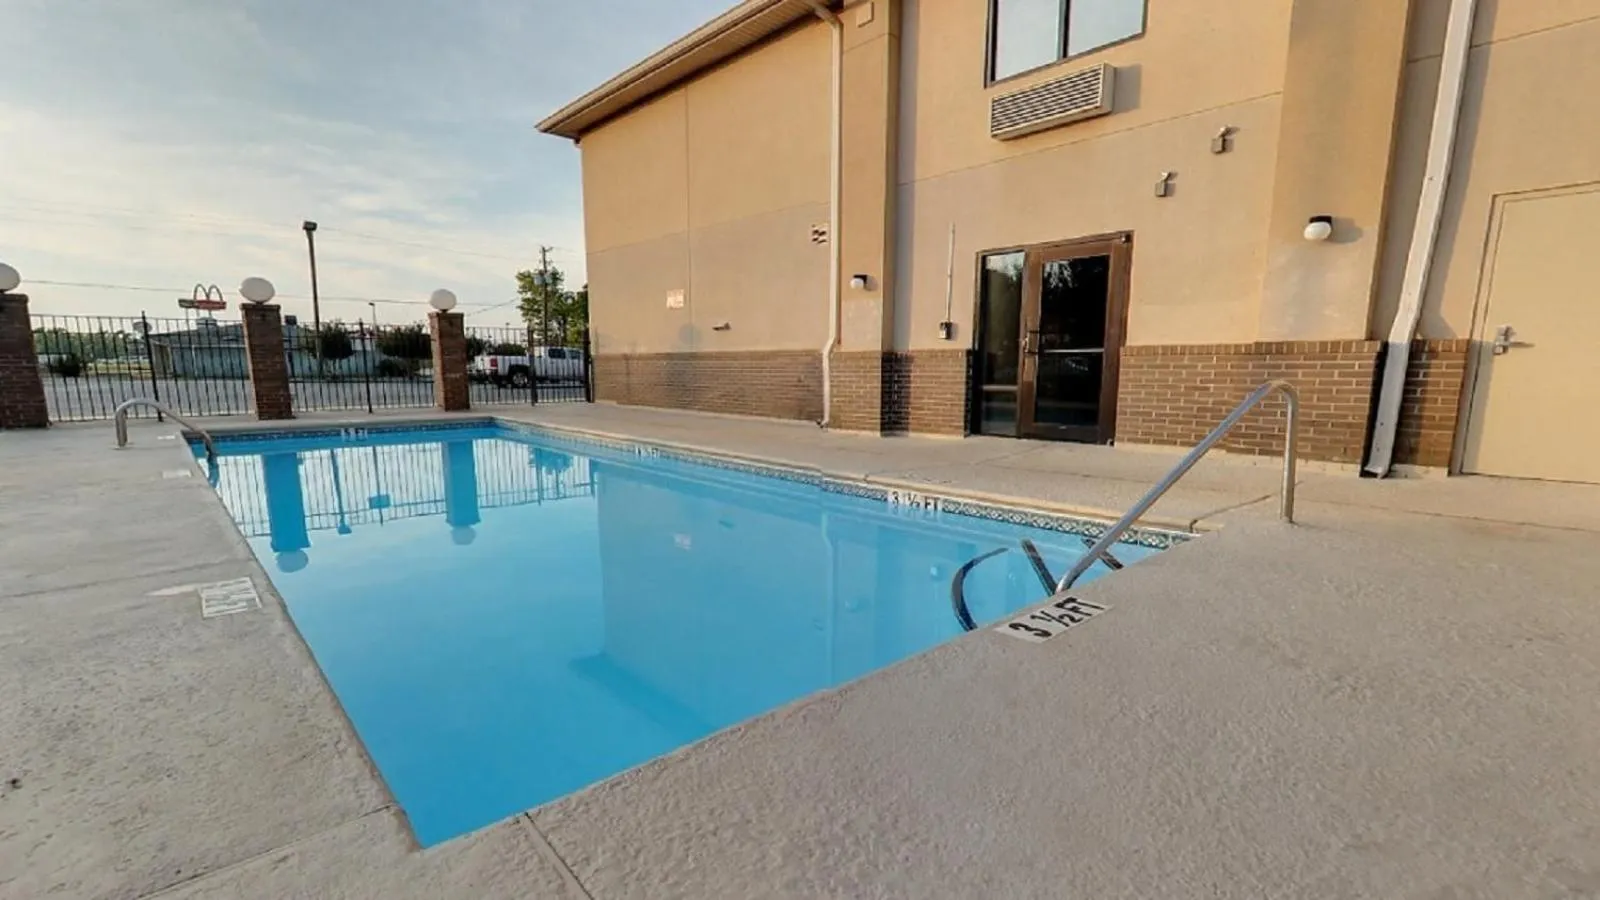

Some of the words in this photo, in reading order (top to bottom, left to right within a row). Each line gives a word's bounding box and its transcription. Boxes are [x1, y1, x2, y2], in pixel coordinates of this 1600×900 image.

[924, 496, 940, 511] FT
[1008, 622, 1052, 637] 3
[1054, 596, 1105, 617] FT
